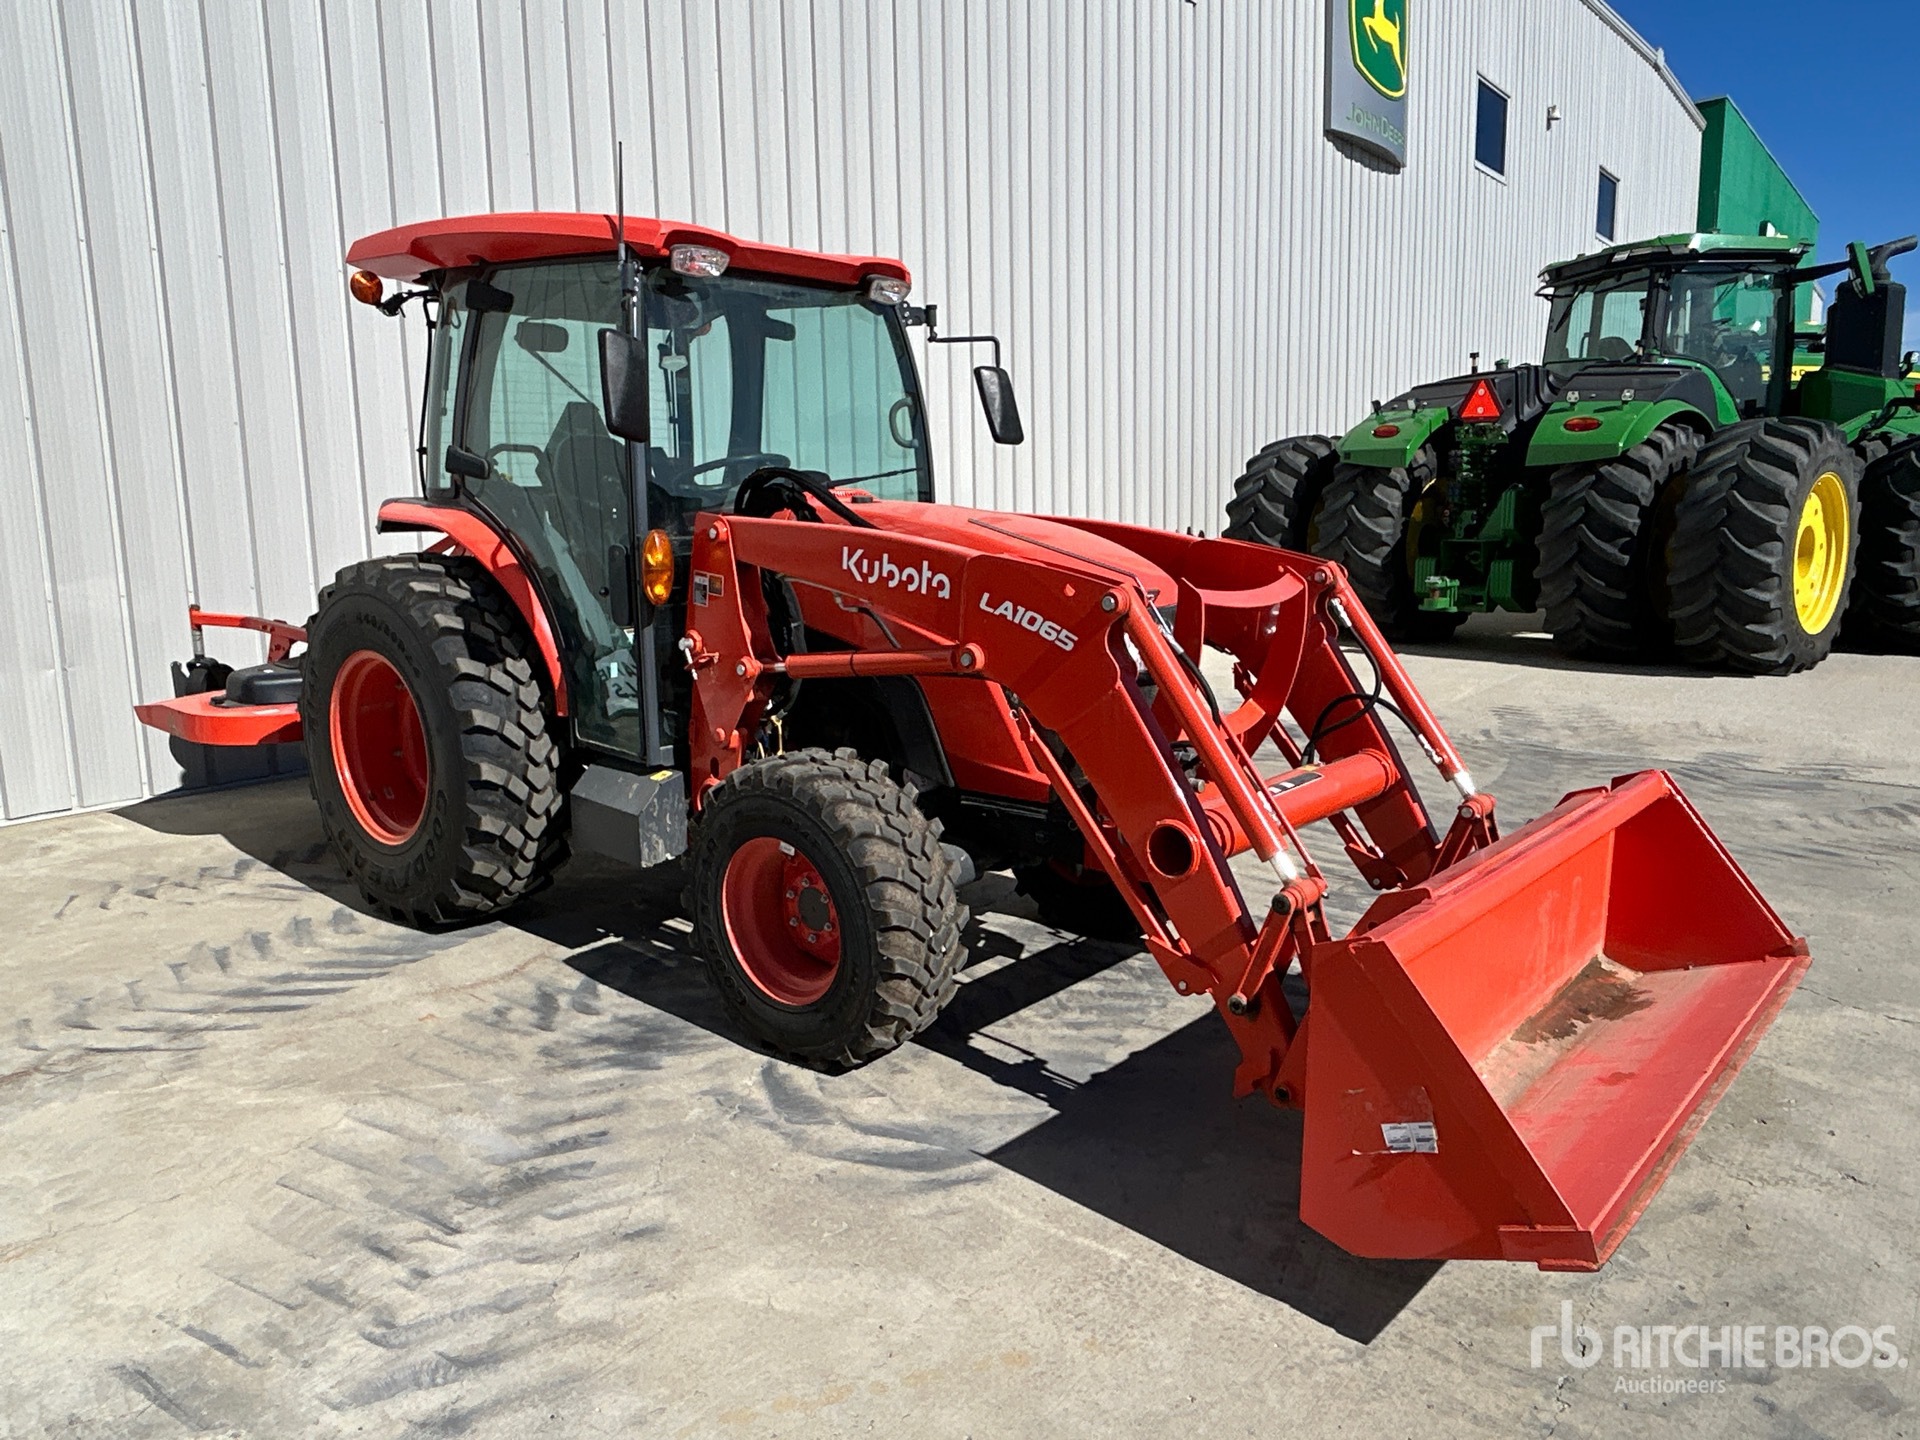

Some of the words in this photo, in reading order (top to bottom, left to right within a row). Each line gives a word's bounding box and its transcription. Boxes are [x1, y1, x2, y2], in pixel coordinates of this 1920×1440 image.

[1346, 102, 1381, 133] JOHN
[842, 546, 950, 599] Kubota
[979, 592, 1078, 651] LA1065
